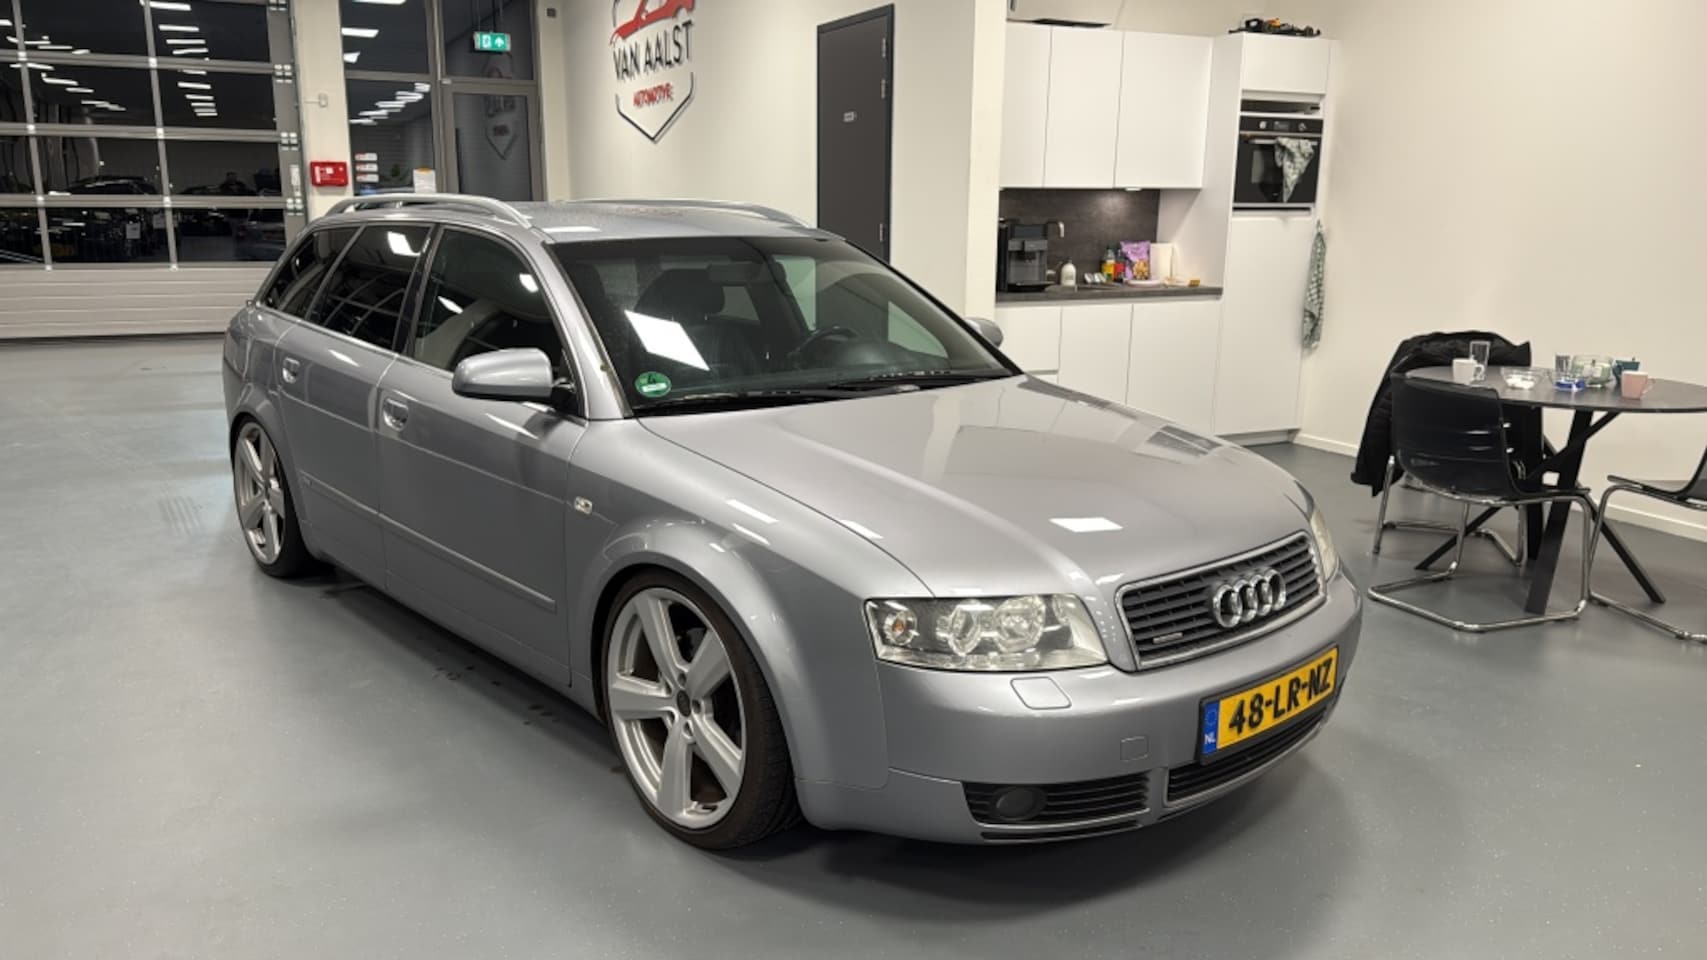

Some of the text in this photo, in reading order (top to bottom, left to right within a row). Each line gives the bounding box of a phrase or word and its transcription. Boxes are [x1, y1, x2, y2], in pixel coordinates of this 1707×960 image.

[613, 20, 692, 80] VAN AALST
[1228, 657, 1333, 735] 48-LR-NZ
[1204, 731, 1216, 745] NL
